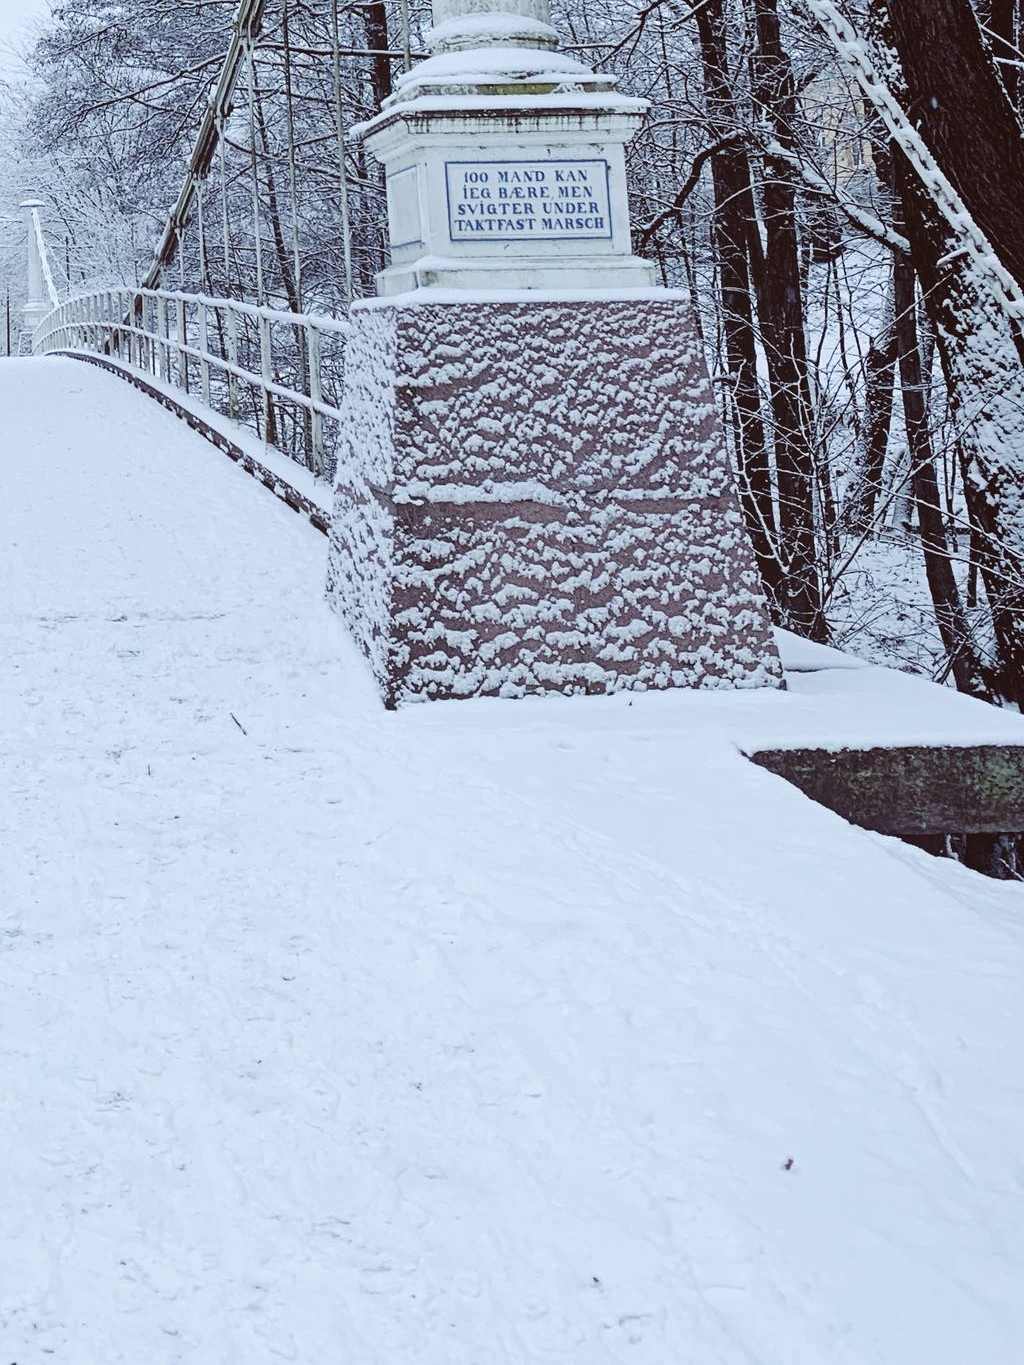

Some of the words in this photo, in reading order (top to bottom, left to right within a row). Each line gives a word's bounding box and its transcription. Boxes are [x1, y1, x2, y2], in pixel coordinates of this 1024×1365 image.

[464, 172, 488, 183] 100
[498, 171, 545, 182] MAND
[555, 170, 588, 181] KAN
[559, 186, 593, 197] MEN
[543, 201, 599, 214] UNDER
[455, 218, 536, 231] TAKTFAST
[542, 217, 604, 230] MARSCH
